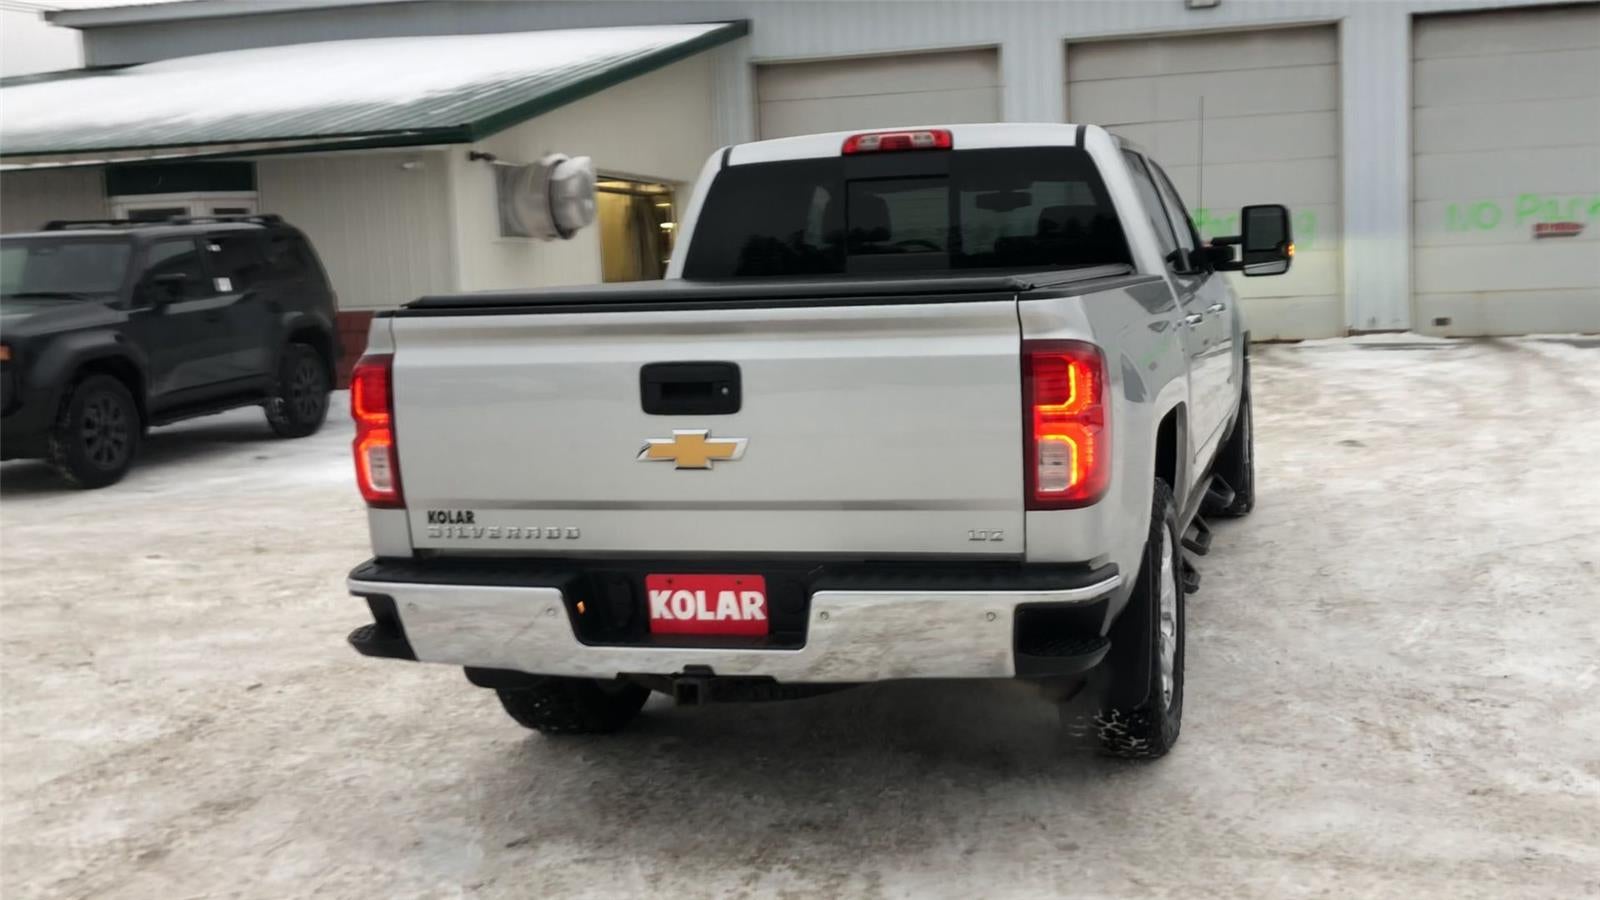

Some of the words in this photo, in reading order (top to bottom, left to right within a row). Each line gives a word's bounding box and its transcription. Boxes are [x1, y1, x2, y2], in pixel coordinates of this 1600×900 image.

[427, 510, 475, 524] KOLAR
[427, 525, 581, 540] SILVERADO
[967, 529, 1004, 542] LTZ
[648, 589, 767, 621] KOLAR
